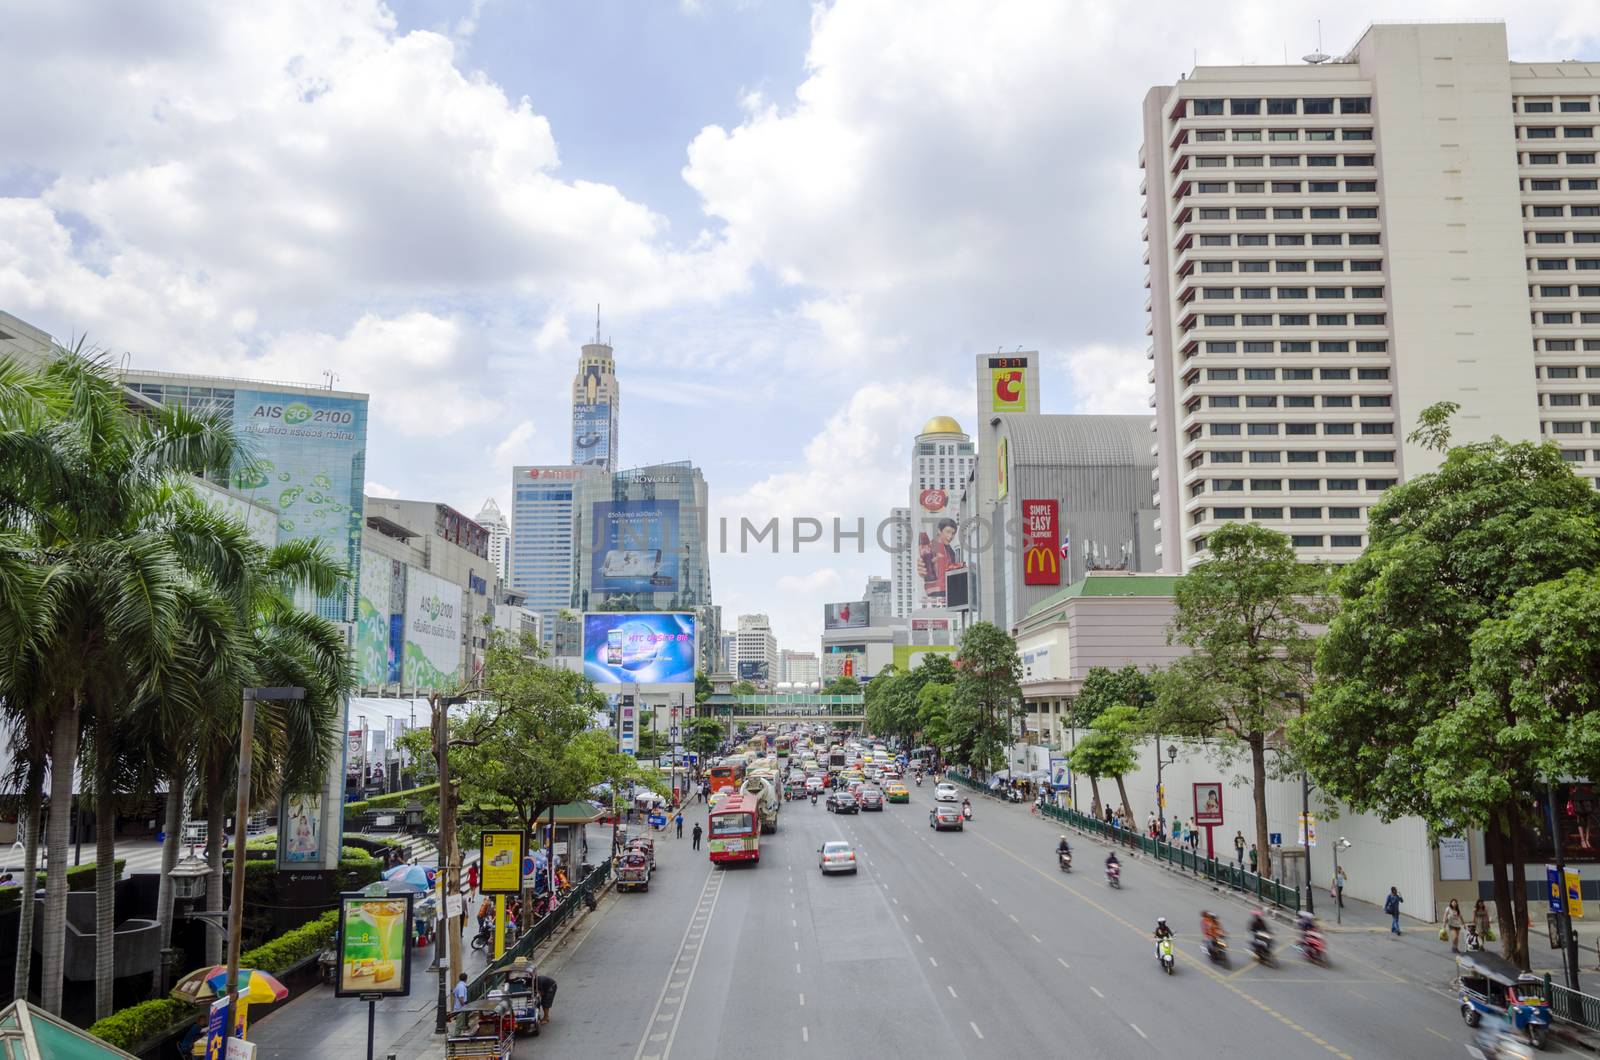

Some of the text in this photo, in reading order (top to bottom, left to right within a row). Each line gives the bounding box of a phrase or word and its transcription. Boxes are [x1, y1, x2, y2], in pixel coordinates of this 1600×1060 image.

[253, 405, 352, 425] AIS 3G 2100
[1029, 504, 1052, 516] SIMPLE
[1030, 516, 1052, 531] EASY
